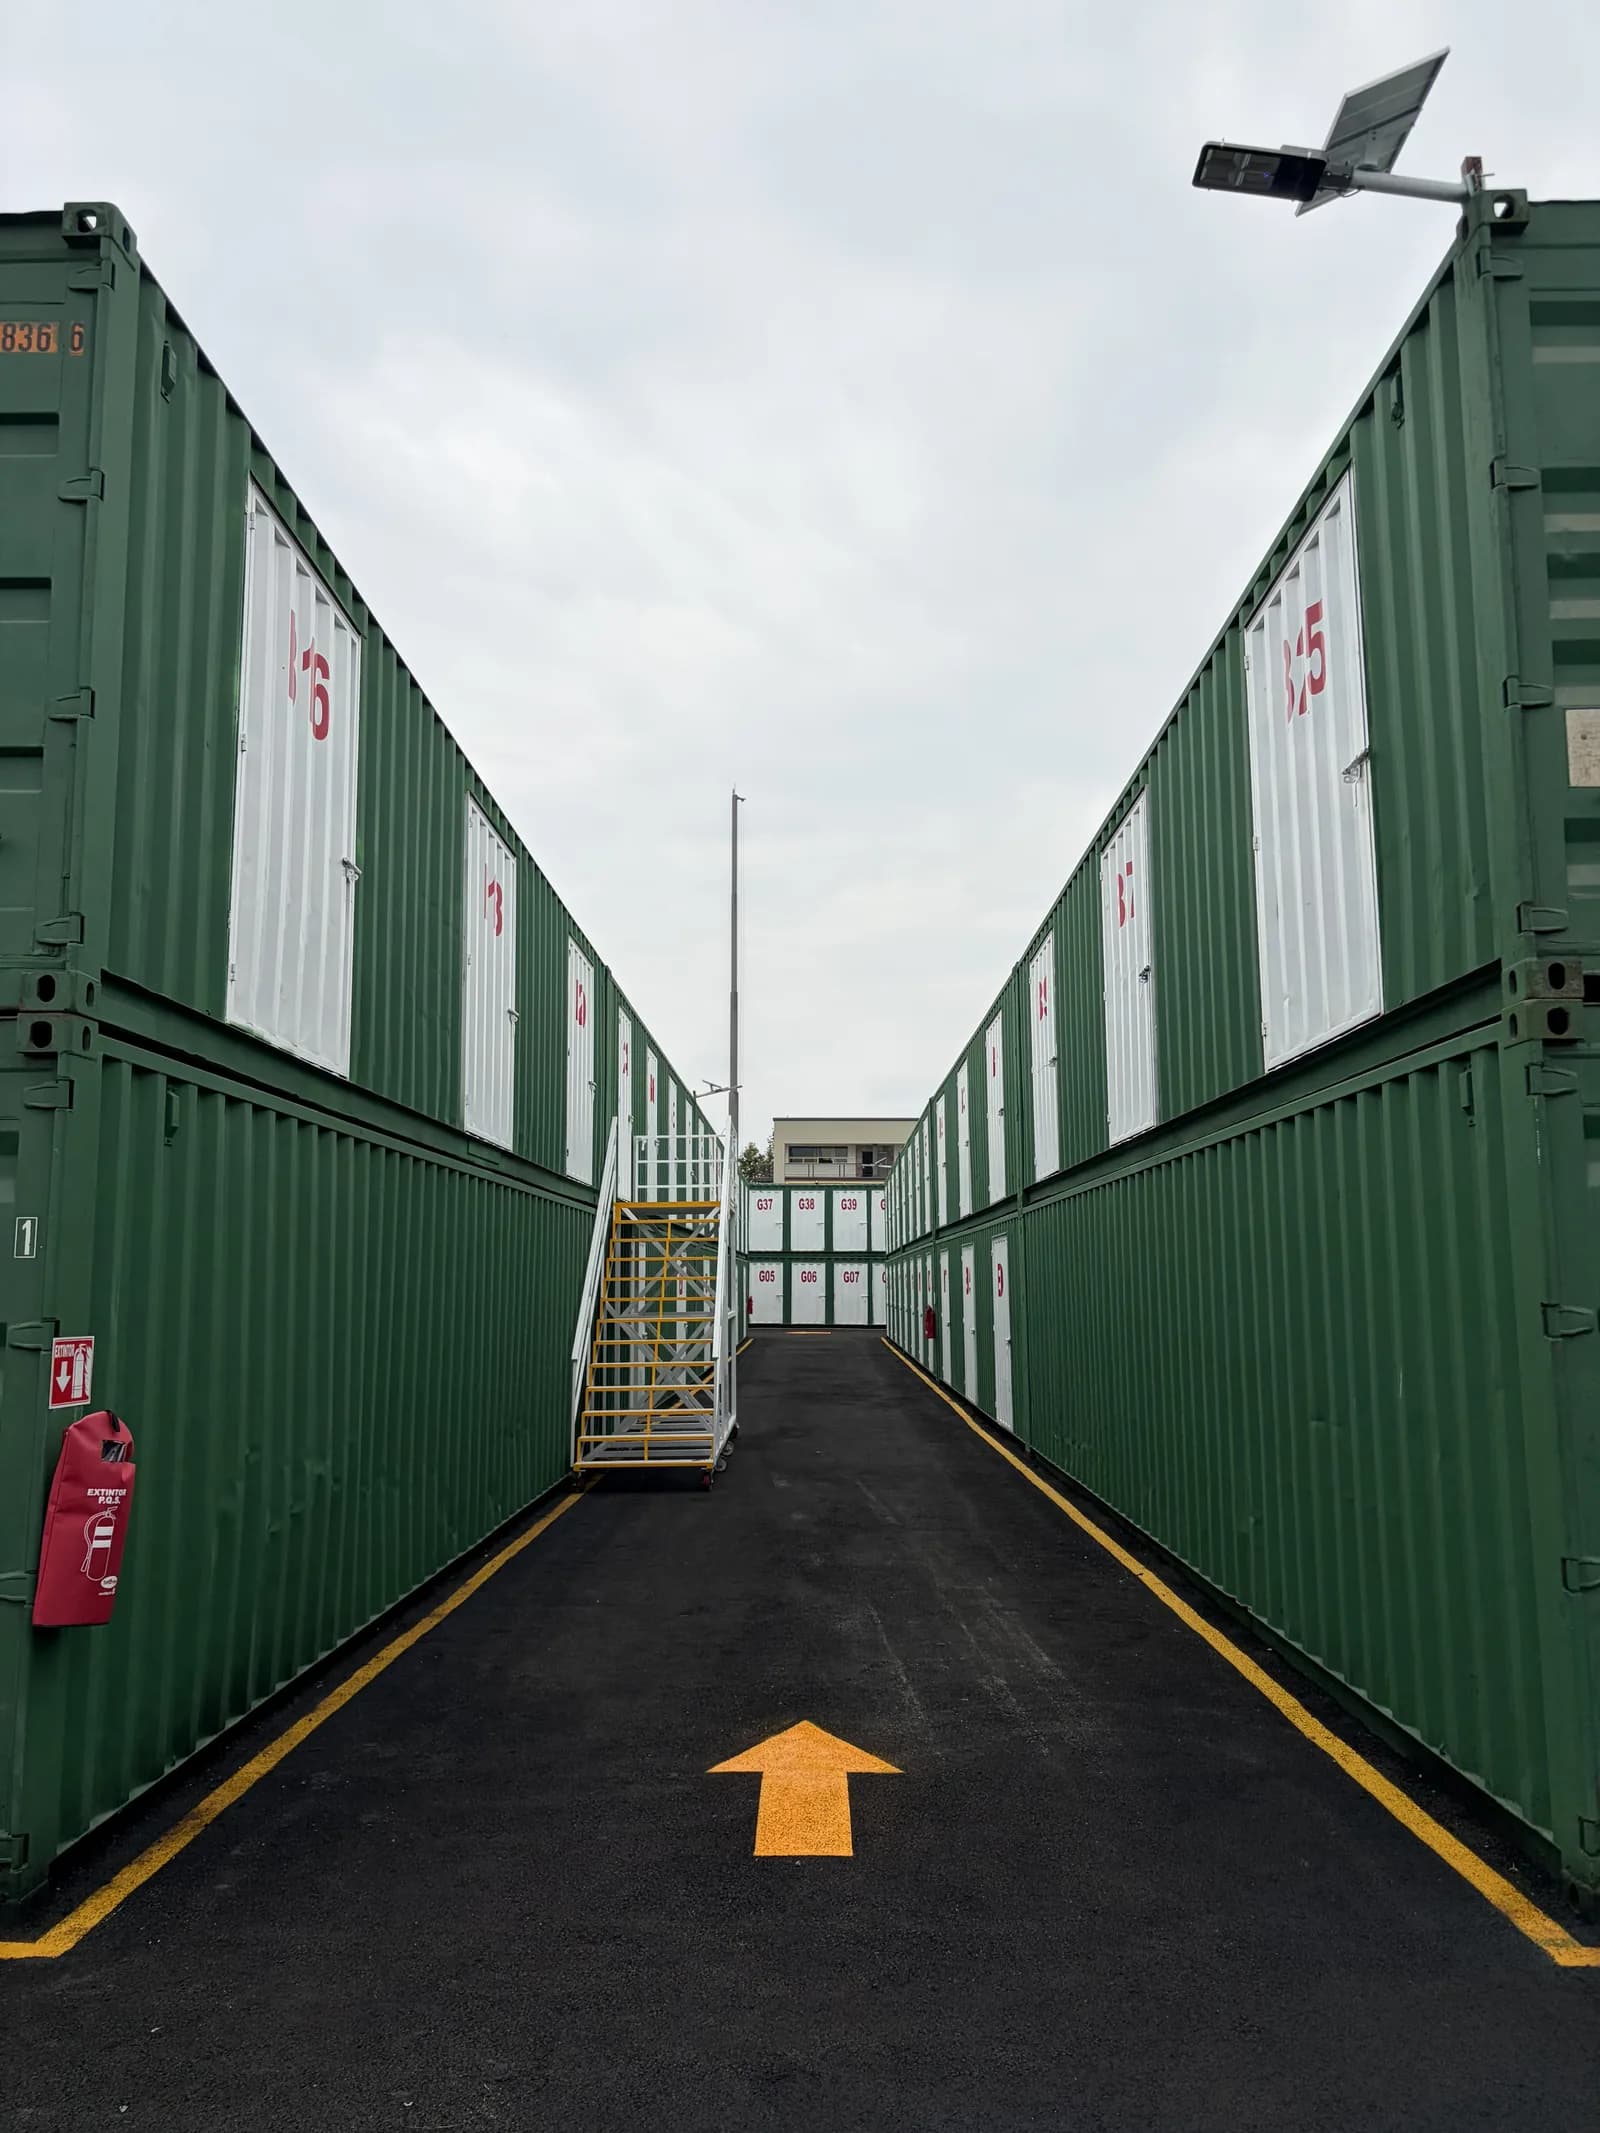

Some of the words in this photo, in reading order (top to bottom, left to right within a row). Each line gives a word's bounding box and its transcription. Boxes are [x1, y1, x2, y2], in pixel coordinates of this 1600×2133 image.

[2, 323, 51, 352] 836
[72, 323, 84, 352] 6
[757, 1198, 773, 1210] G37
[798, 1198, 815, 1210] G38
[841, 1198, 857, 1210] G39
[22, 1219, 31, 1255] 1
[759, 1270, 775, 1282] G05
[801, 1271, 817, 1283] G06
[843, 1271, 860, 1283] G07
